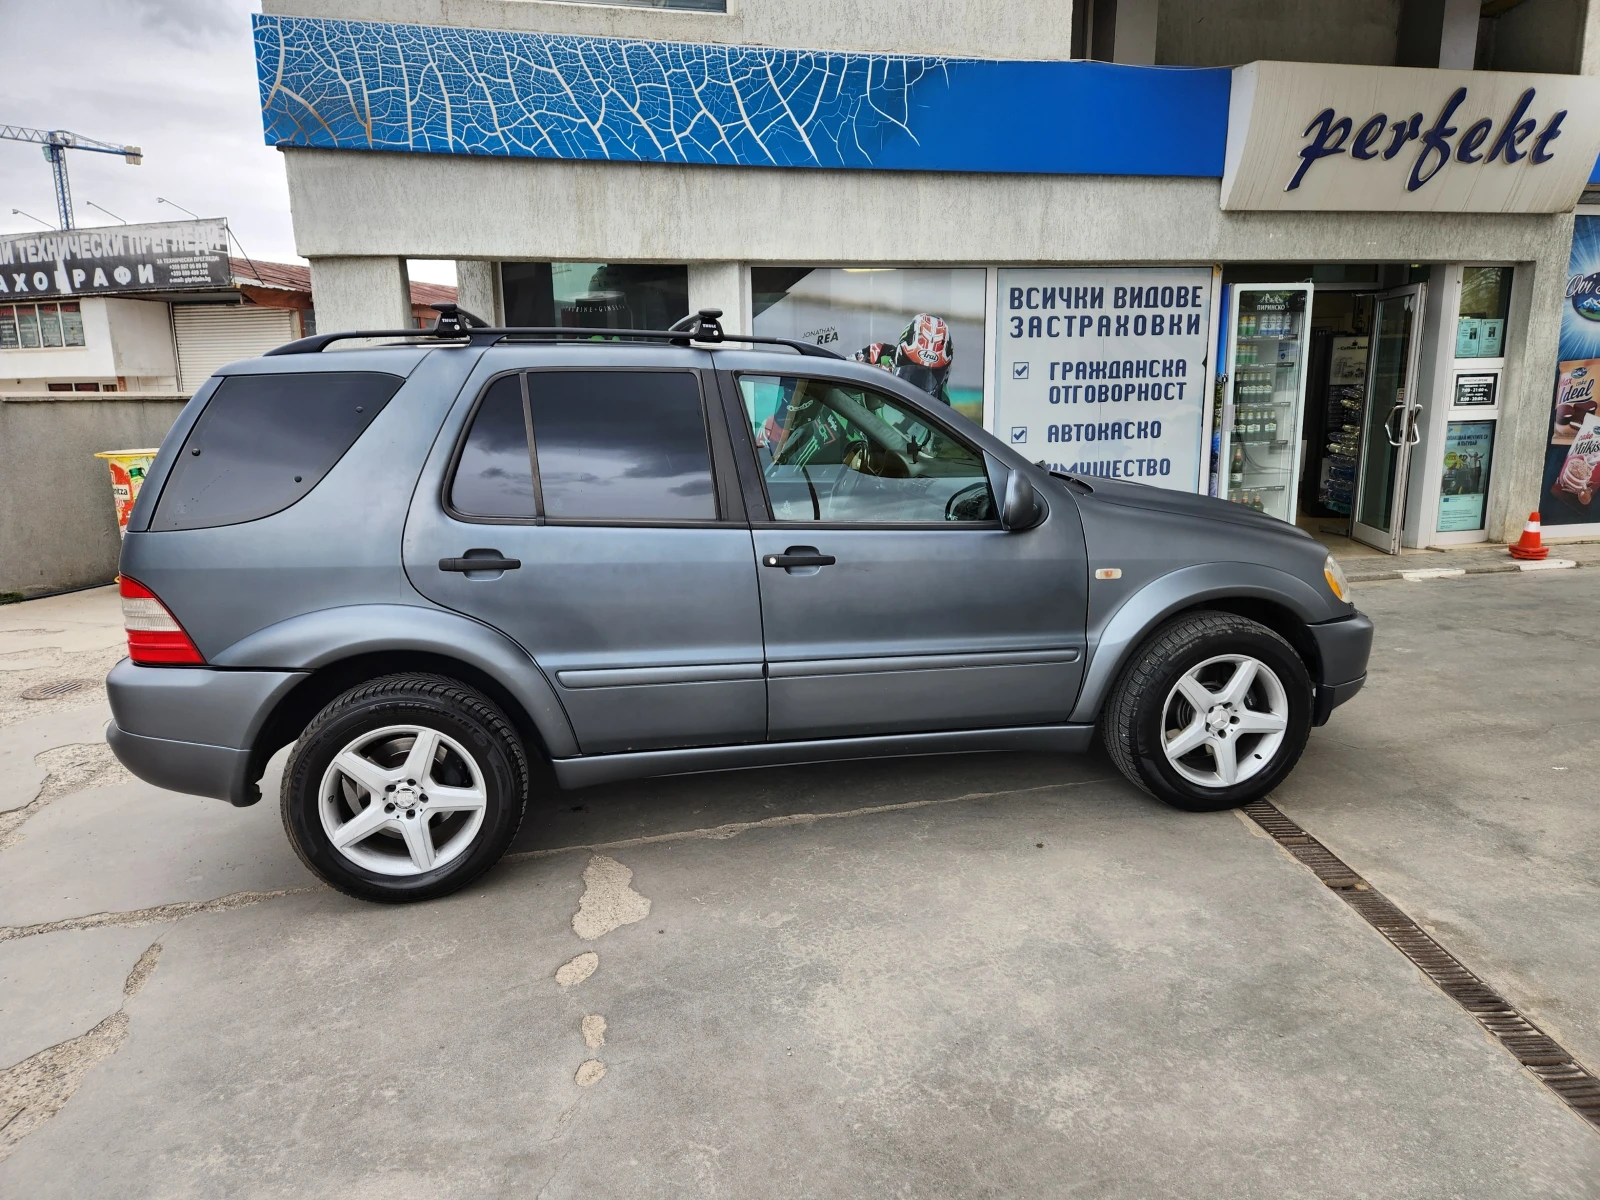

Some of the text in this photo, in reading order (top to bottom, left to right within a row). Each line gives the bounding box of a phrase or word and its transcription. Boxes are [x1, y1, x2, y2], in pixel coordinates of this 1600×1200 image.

[1283, 86, 1568, 192] perfekt
[16, 232, 124, 263] ТЕХНИЧЕСКИ
[1009, 286, 1203, 310] ВСИЧКИ ВИДОВЕ
[802, 325, 836, 339] JONATHAN
[1009, 313, 1200, 338] ЗАСТРАХОВКИ
[816, 331, 839, 345] REA
[922, 351, 937, 360] Arai
[1050, 359, 1187, 380] ГРАЖДАНСКА
[1049, 382, 1187, 405] ОТГОВОРНОСТ
[1559, 378, 1595, 404] Ideal
[1047, 420, 1162, 443] АВТОКАСКО
